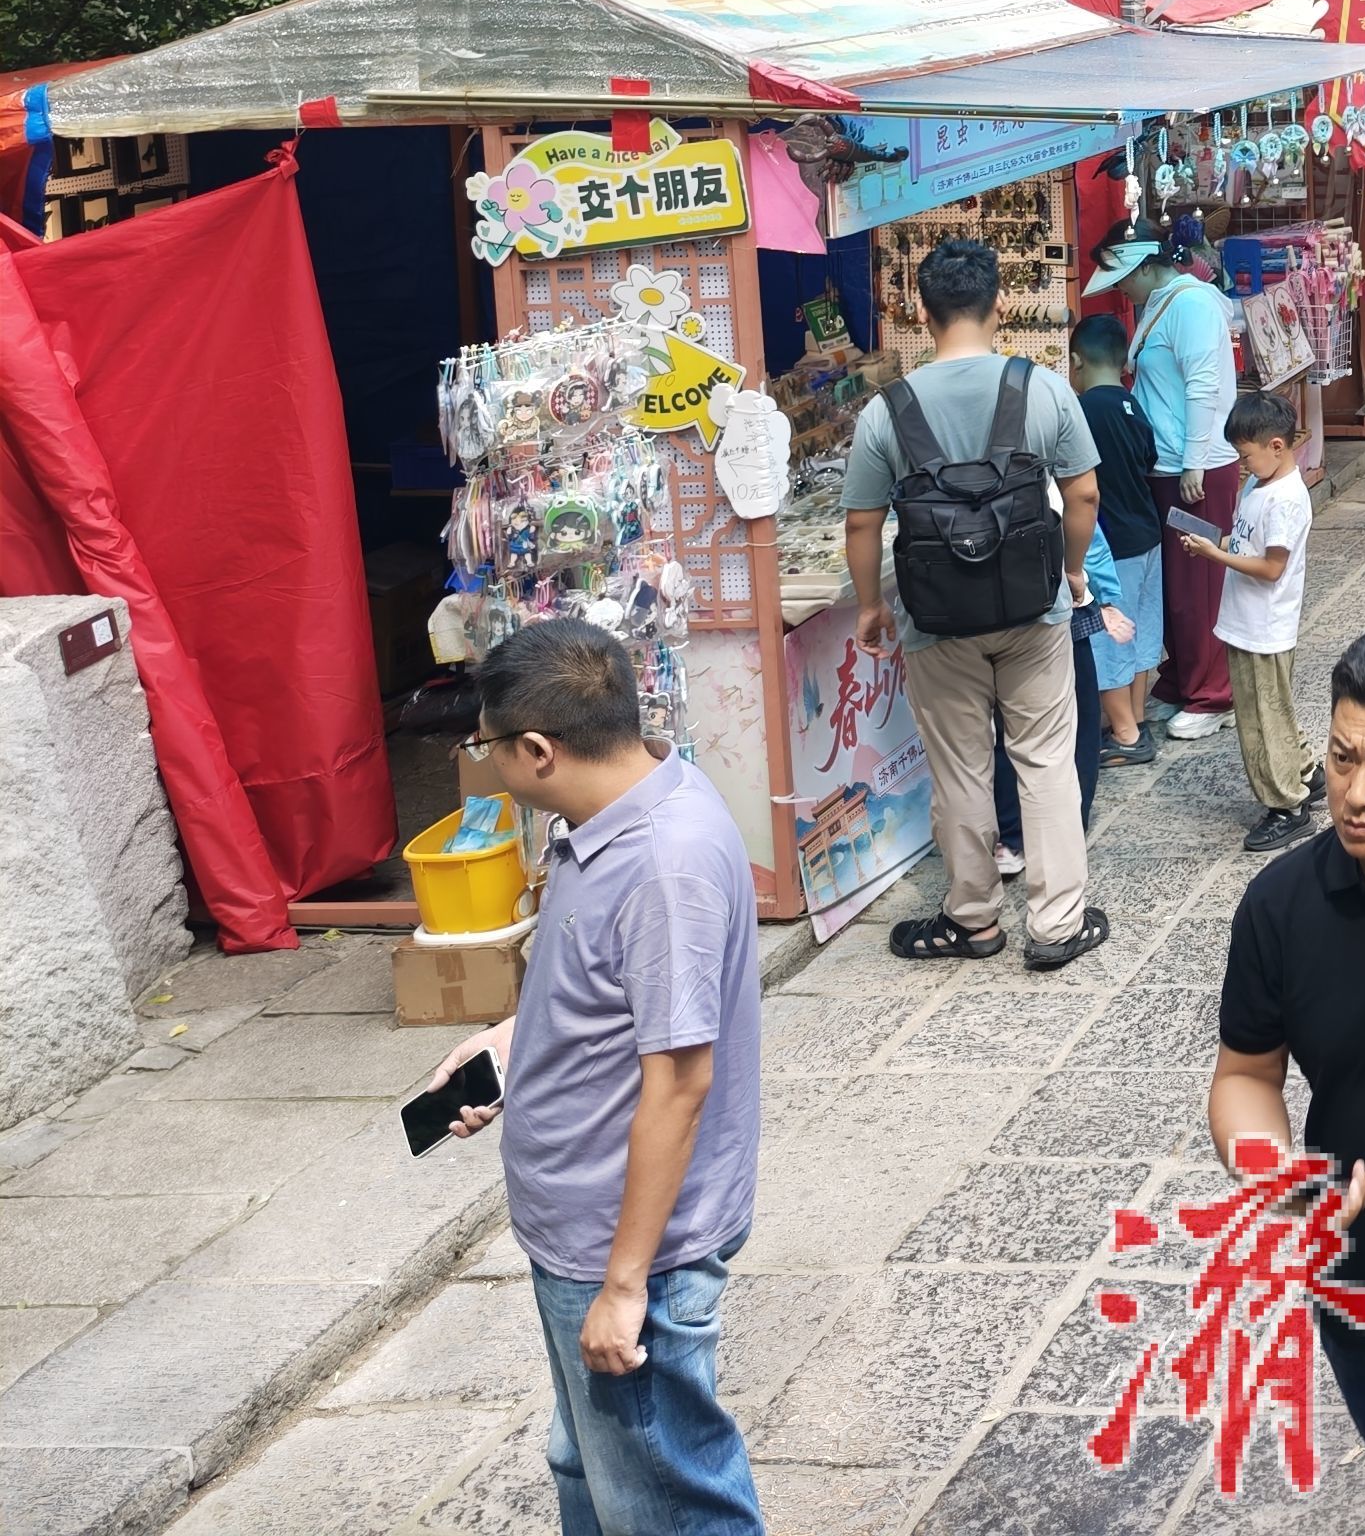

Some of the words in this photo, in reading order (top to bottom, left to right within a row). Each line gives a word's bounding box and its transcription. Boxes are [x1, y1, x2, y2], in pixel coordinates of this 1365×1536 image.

[545, 146, 587, 165] Have
[591, 148, 601, 160] a
[605, 149, 640, 164] nice
[644, 135, 670, 158] ay
[577, 165, 728, 222] 交个朋友
[643, 366, 732, 414] ELCOME
